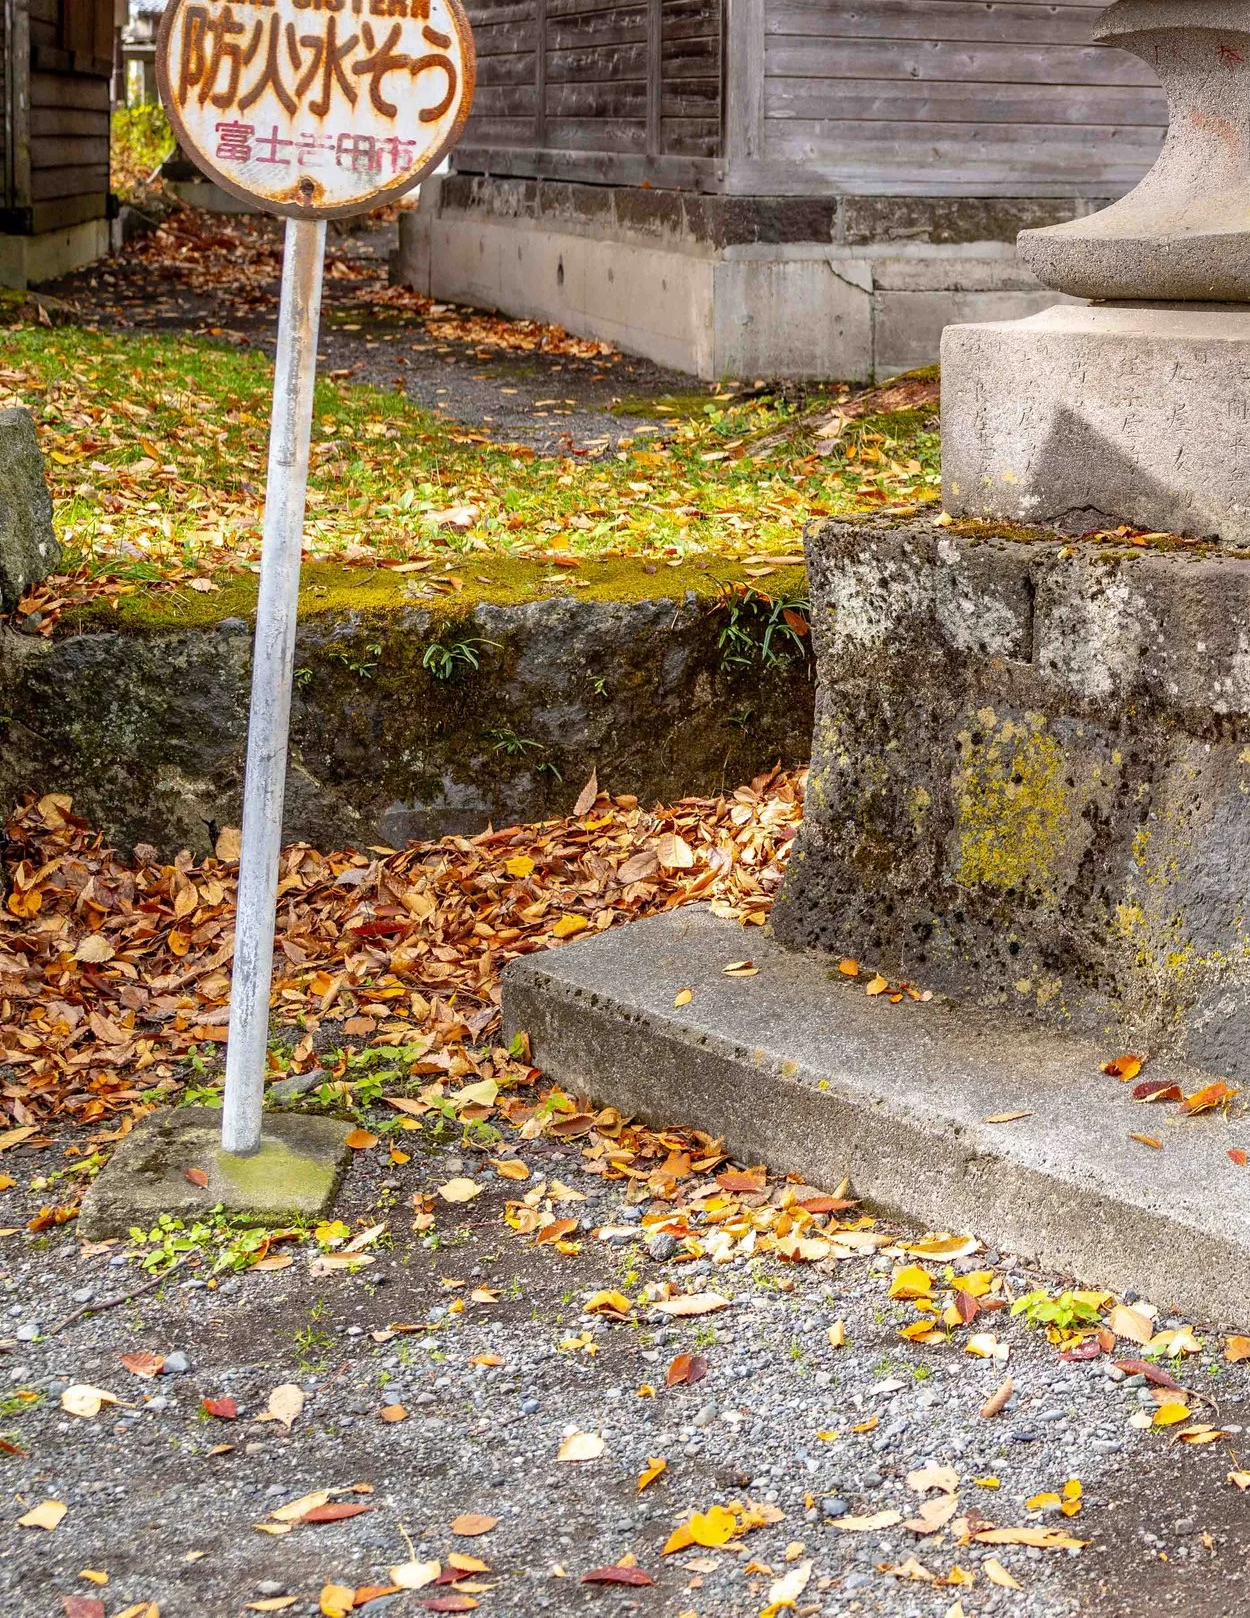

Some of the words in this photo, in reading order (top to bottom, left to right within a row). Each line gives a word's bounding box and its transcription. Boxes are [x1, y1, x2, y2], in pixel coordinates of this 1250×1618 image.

[180, 5, 457, 123] 防火水そう
